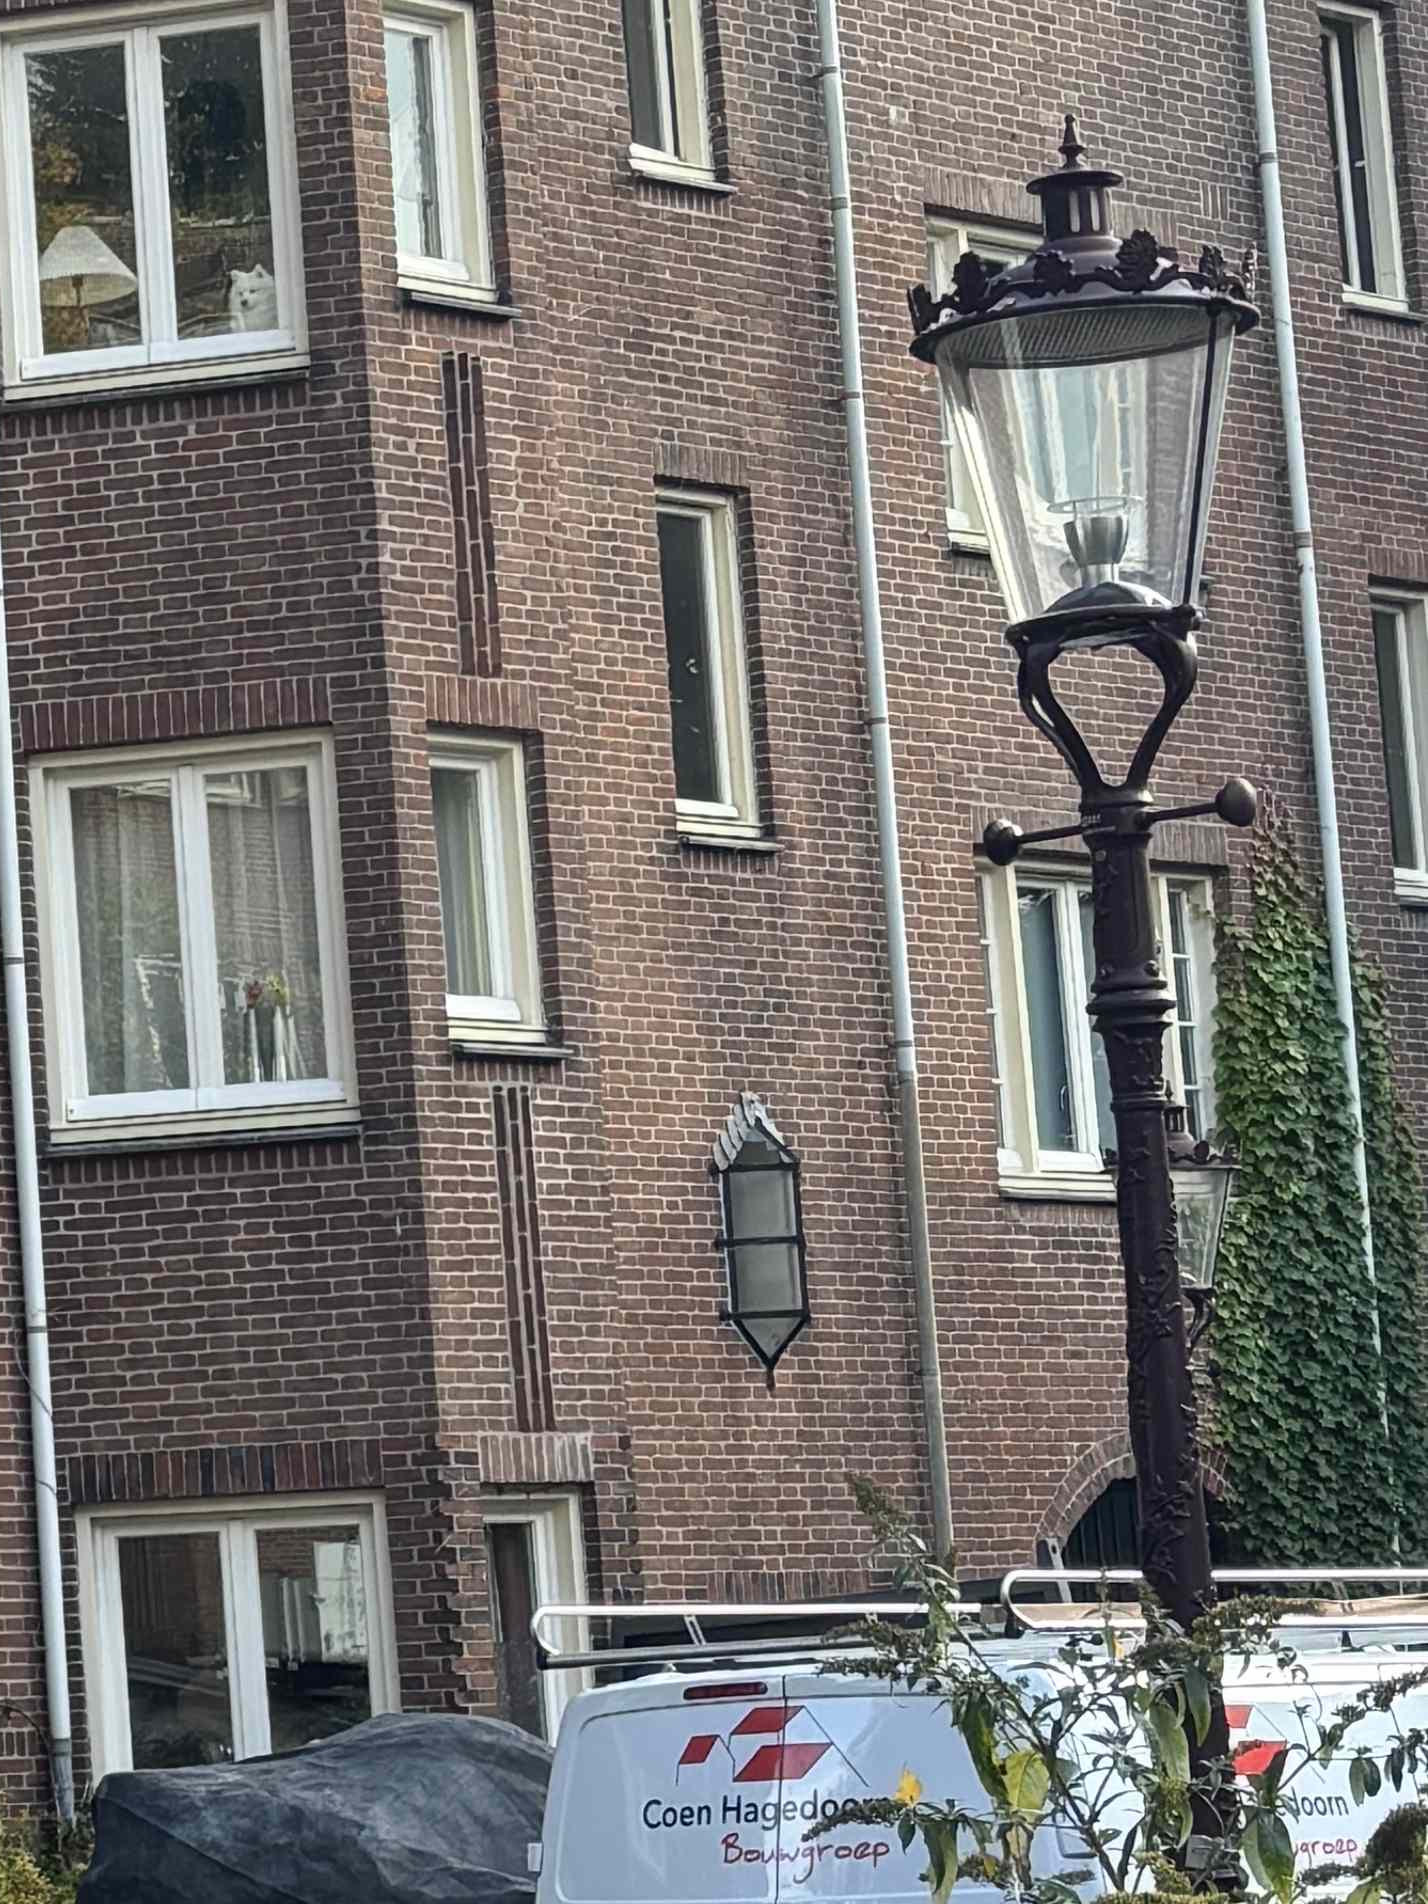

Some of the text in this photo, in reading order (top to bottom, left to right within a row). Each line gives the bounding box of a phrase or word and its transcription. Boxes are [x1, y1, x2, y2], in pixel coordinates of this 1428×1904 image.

[643, 1787, 896, 1831] Coen Hagedoo
[721, 1832, 890, 1884] Bouwgroep
[1294, 1839, 1357, 1867] groep
